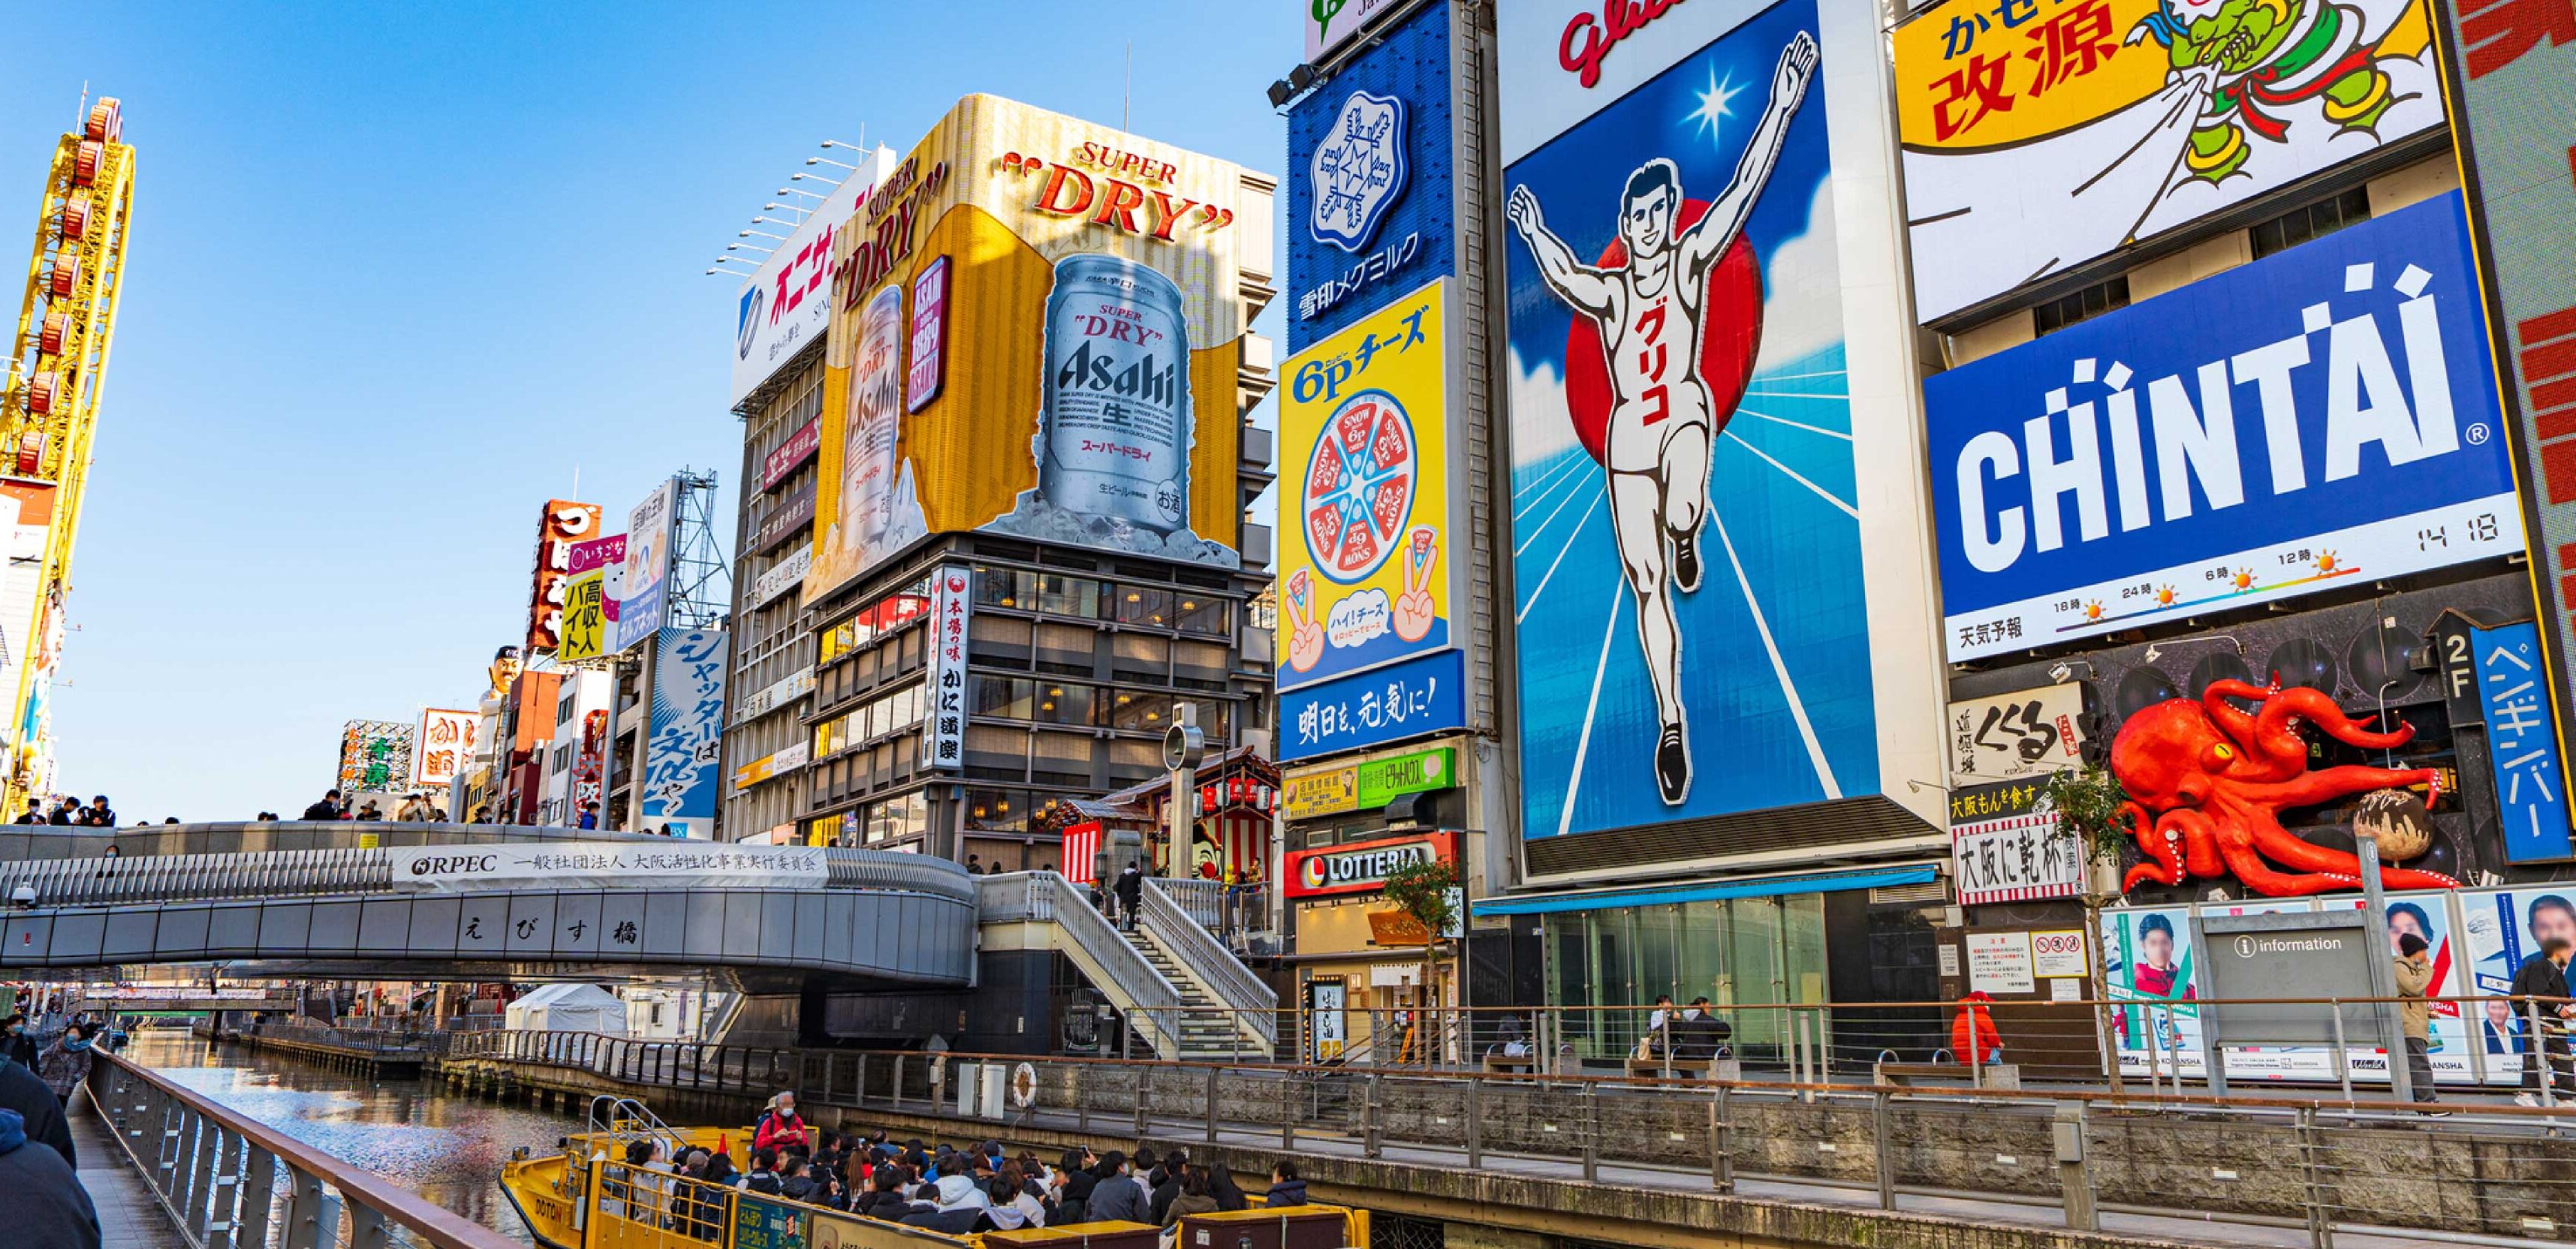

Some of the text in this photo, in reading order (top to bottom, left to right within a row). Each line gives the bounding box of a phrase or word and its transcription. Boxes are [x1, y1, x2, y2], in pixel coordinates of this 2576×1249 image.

[1929, 0, 2119, 143] 改源
[867, 157, 917, 226] SUPER
[1079, 142, 1177, 185] SUPER
[1001, 152, 1234, 242] "DRY"
[1299, 231, 1419, 321] 雪印メグミルク
[1075, 315, 1162, 347] "DRY"
[1099, 305, 1142, 322] SUPER
[1059, 340, 1174, 410] Asahi
[1634, 295, 1669, 426] グリコ
[851, 369, 895, 443] Asahi
[1102, 402, 1132, 427] 生
[1957, 262, 2460, 573] CHINTAI
[1081, 439, 1151, 462] スーパードライ
[2279, 549, 2311, 566] 12時
[2418, 515, 2498, 552] 14 18
[2053, 598, 2080, 614] 18時
[2123, 583, 2152, 599] 24時
[2206, 567, 2228, 582] 6時
[565, 582, 586, 657] バイト
[580, 579, 602, 655] 高収入
[945, 598, 963, 662] 本場の味
[1960, 618, 2023, 648] 天気予報
[676, 634, 723, 762] シャッターは
[2446, 635, 2471, 698] 2F
[939, 667, 962, 760] かに道楽
[1956, 709, 1976, 774] 道頓堀
[1975, 700, 2058, 763] くくる
[2486, 643, 2553, 838] ペンギンバー
[411, 853, 817, 875] ORPEC 一般社団法人 大阪活性化事業実行委員会
[1330, 847, 1421, 880] LOTTERIA
[1960, 827, 2062, 889] 大阪に乾杯
[465, 916, 638, 944] えびす橋
[2260, 936, 2343, 953] information
